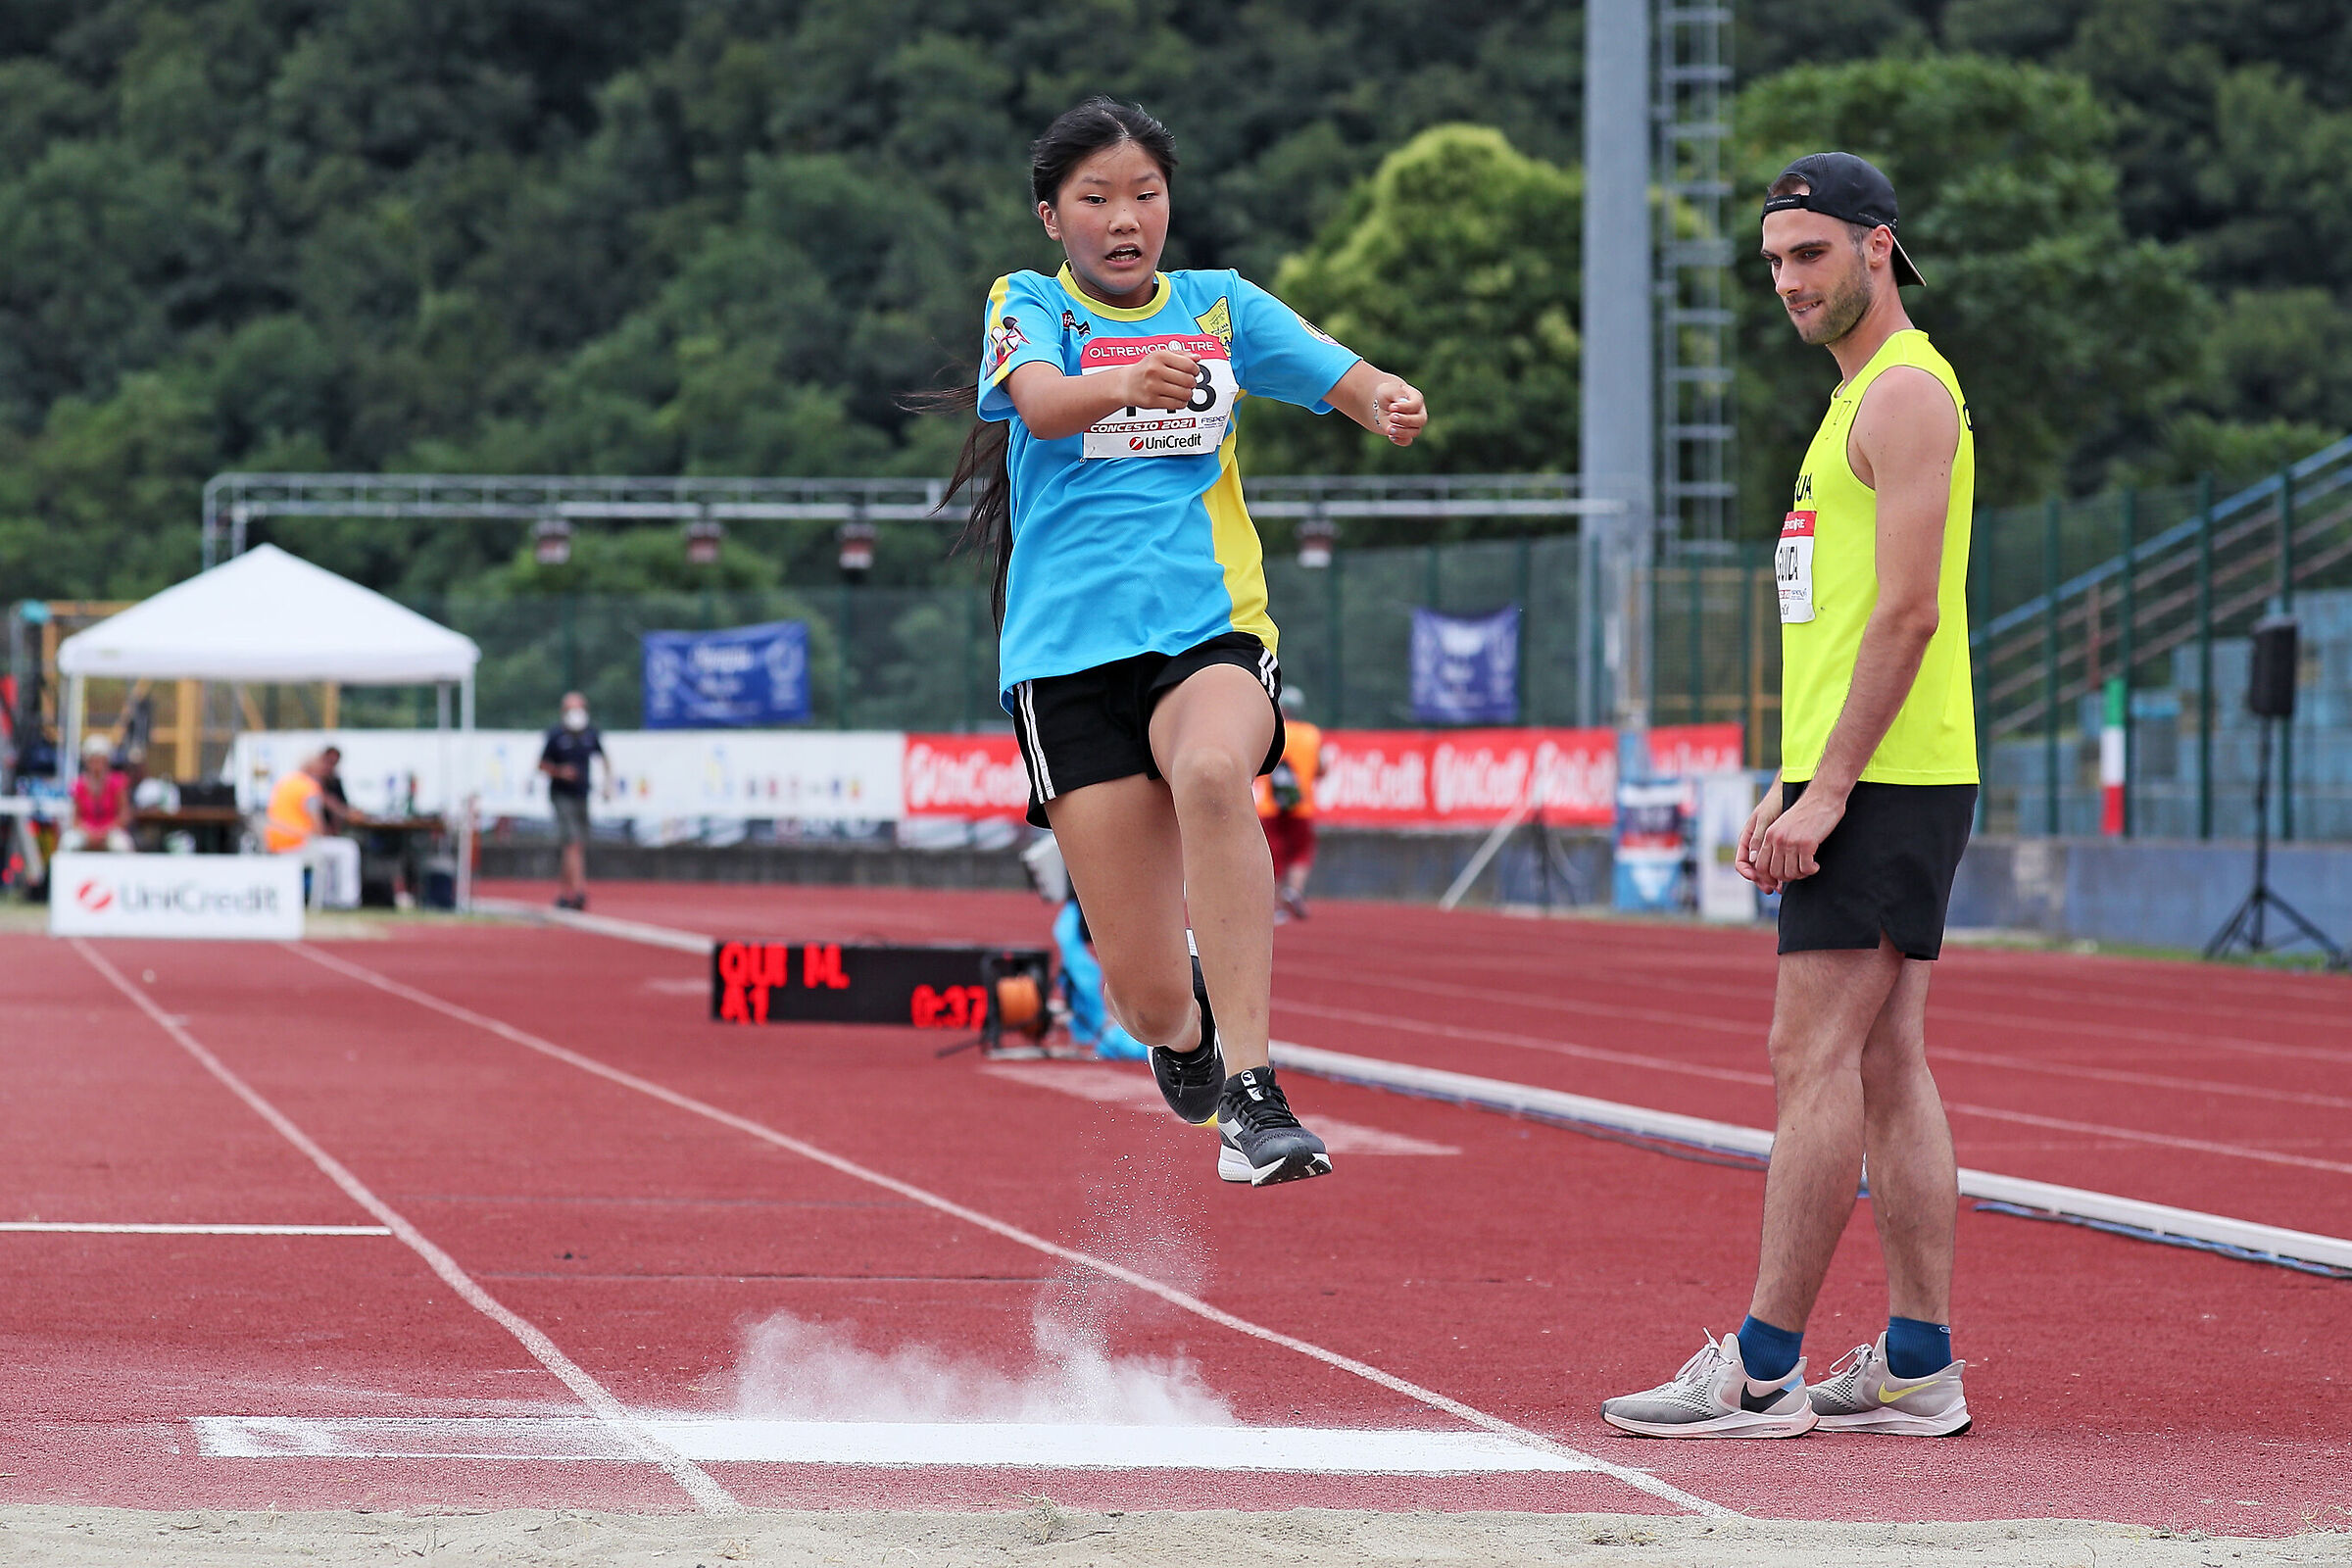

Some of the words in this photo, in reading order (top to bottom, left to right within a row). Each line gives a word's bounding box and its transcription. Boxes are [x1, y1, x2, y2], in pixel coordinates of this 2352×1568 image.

[1090, 421, 1159, 433] CONCESIO
[1161, 418, 1195, 430] 2021
[1145, 432, 1202, 450] UniCredit
